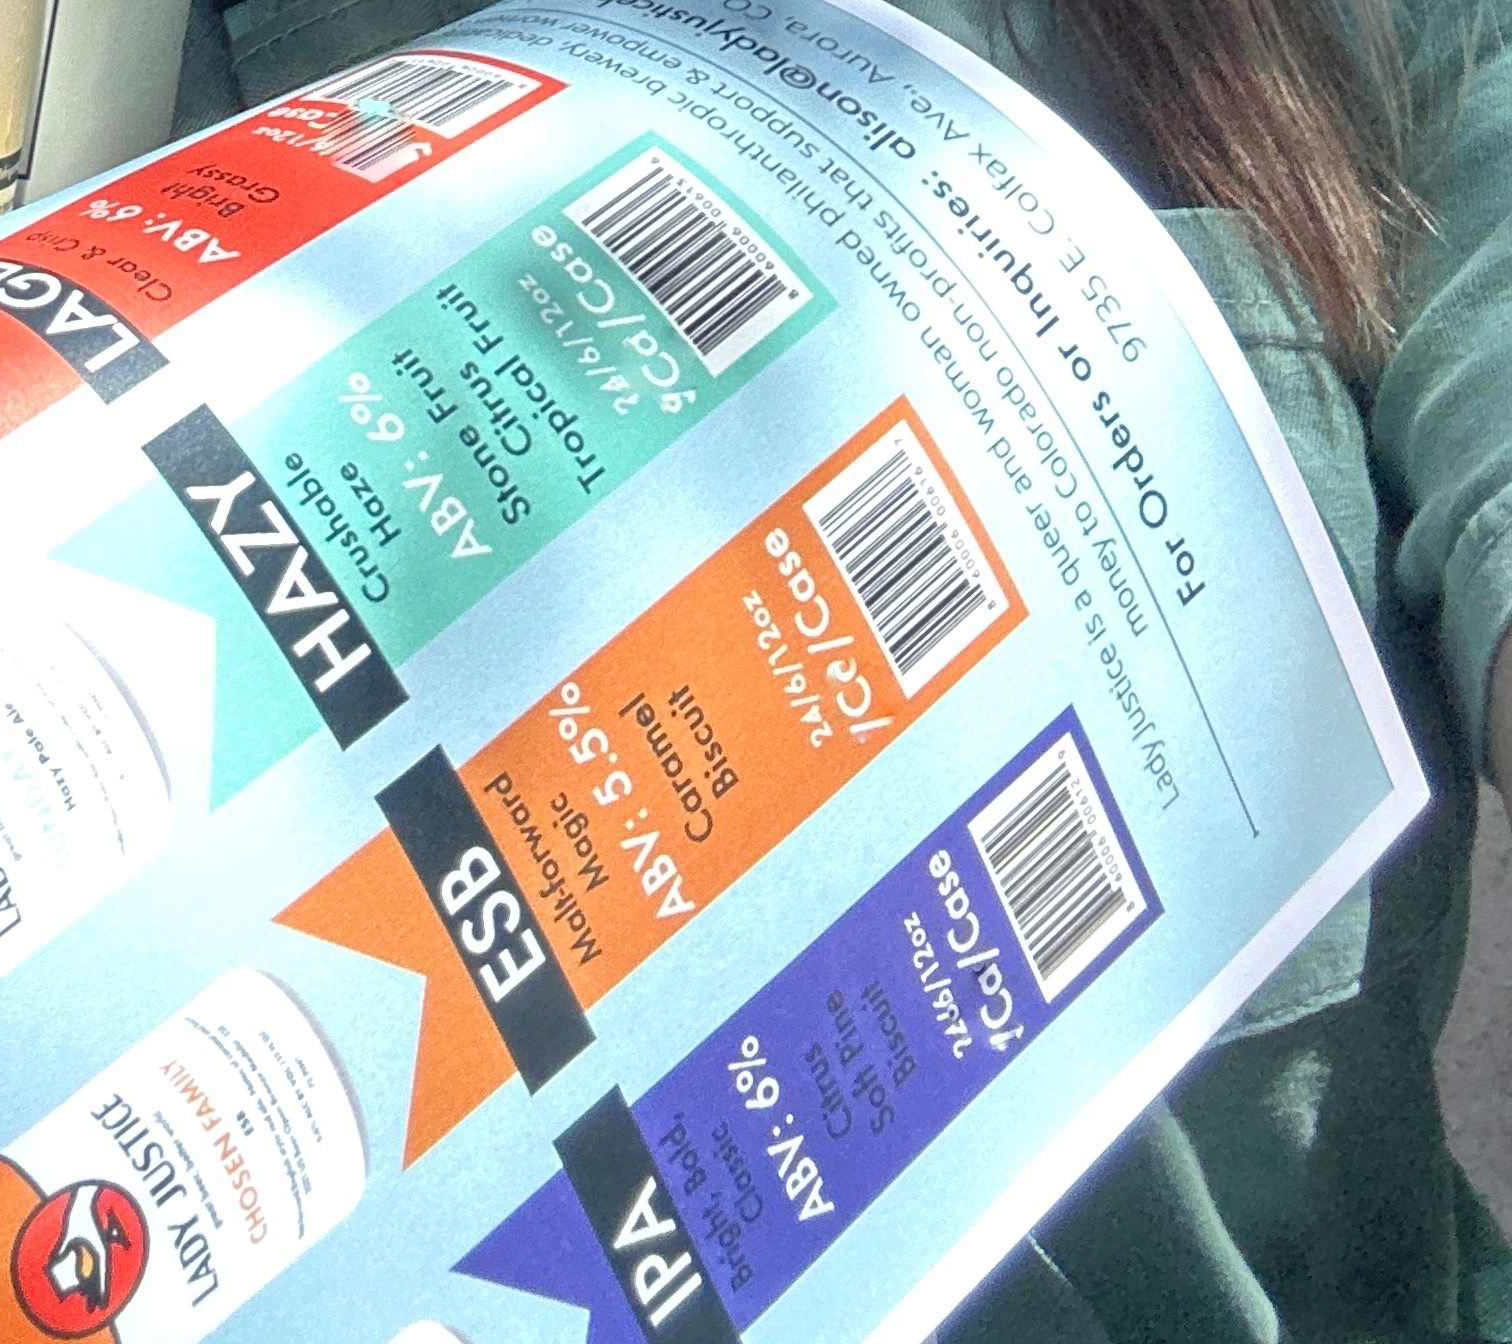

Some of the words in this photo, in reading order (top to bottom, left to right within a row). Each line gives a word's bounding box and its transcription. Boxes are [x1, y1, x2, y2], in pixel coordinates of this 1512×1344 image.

[559, 22, 683, 69] empower
[562, 40, 668, 96] brewery,
[685, 67, 711, 85] &
[783, 15, 895, 84] Aurora,
[710, 81, 820, 159] support
[902, 83, 970, 141] Ave.,
[160, 182, 246, 219] Bright
[185, 162, 281, 204] Grassy
[667, 91, 846, 228] philanthropic
[817, 157, 874, 211] that
[968, 142, 1055, 235] Colfax
[25, 230, 81, 252] Crisp
[79, 199, 143, 222] 6%
[80, 245, 107, 261] &
[142, 213, 241, 264] ABV:
[731, 226, 775, 271] 60006
[106, 257, 172, 302] Clear
[834, 228, 921, 322] owned
[872, 209, 998, 362] non-profits
[921, 170, 1060, 338] Inquiries:
[1059, 246, 1087, 274] E.
[435, 283, 505, 356] Fruit
[1080, 275, 1148, 363] 9735
[391, 348, 459, 425] Fruit
[920, 325, 995, 435] woman
[1057, 343, 1092, 382] or
[337, 370, 405, 442] 6%
[459, 361, 532, 457] Citrus
[493, 354, 606, 495] Tropical
[996, 366, 1078, 499] Colorado
[458, 424, 531, 525] Stone
[986, 436, 1033, 495] and
[1092, 391, 1168, 529] Orders
[285, 452, 391, 604] Crushable
[340, 462, 403, 548] Haze
[400, 450, 493, 559] ABV:
[1025, 502, 1080, 586] queer
[1075, 500, 1099, 537] to
[185, 470, 372, 693] HAZY
[950, 529, 981, 579] 60006
[1091, 537, 1149, 638] money
[1165, 537, 1206, 607] For
[1074, 588, 1092, 612] a
[1085, 613, 1107, 647] is
[742, 589, 833, 748] 24/6/12oz
[1099, 643, 1156, 742] Justice
[4, 703, 25, 724] Ale
[25, 728, 51, 765] Pale
[548, 682, 633, 806] 5.5%
[667, 684, 740, 801] Biscuit
[49, 767, 77, 812] Hazy
[617, 691, 714, 843] Caramel
[1141, 739, 1180, 811] Lady
[482, 770, 603, 967] Malt-forward
[550, 791, 610, 893] Magic
[623, 807, 696, 918] ABV:
[440, 846, 546, 1003] ESB
[815, 984, 869, 1071] Pine
[852, 975, 924, 1089] Biscuit
[161, 1059, 222, 1132] FAMILY
[727, 1035, 780, 1110] 6%
[794, 1038, 861, 1145] Citrus
[90, 1093, 187, 1208] JUSTICE
[236, 1110, 255, 1137] ESB
[652, 1106, 713, 1199] Bold,
[213, 1131, 268, 1245] CHOSEN
[702, 1118, 771, 1228] Classic
[767, 1113, 835, 1222] ABV:
[167, 1214, 219, 1307] LADY
[612, 1176, 703, 1328] IPA
